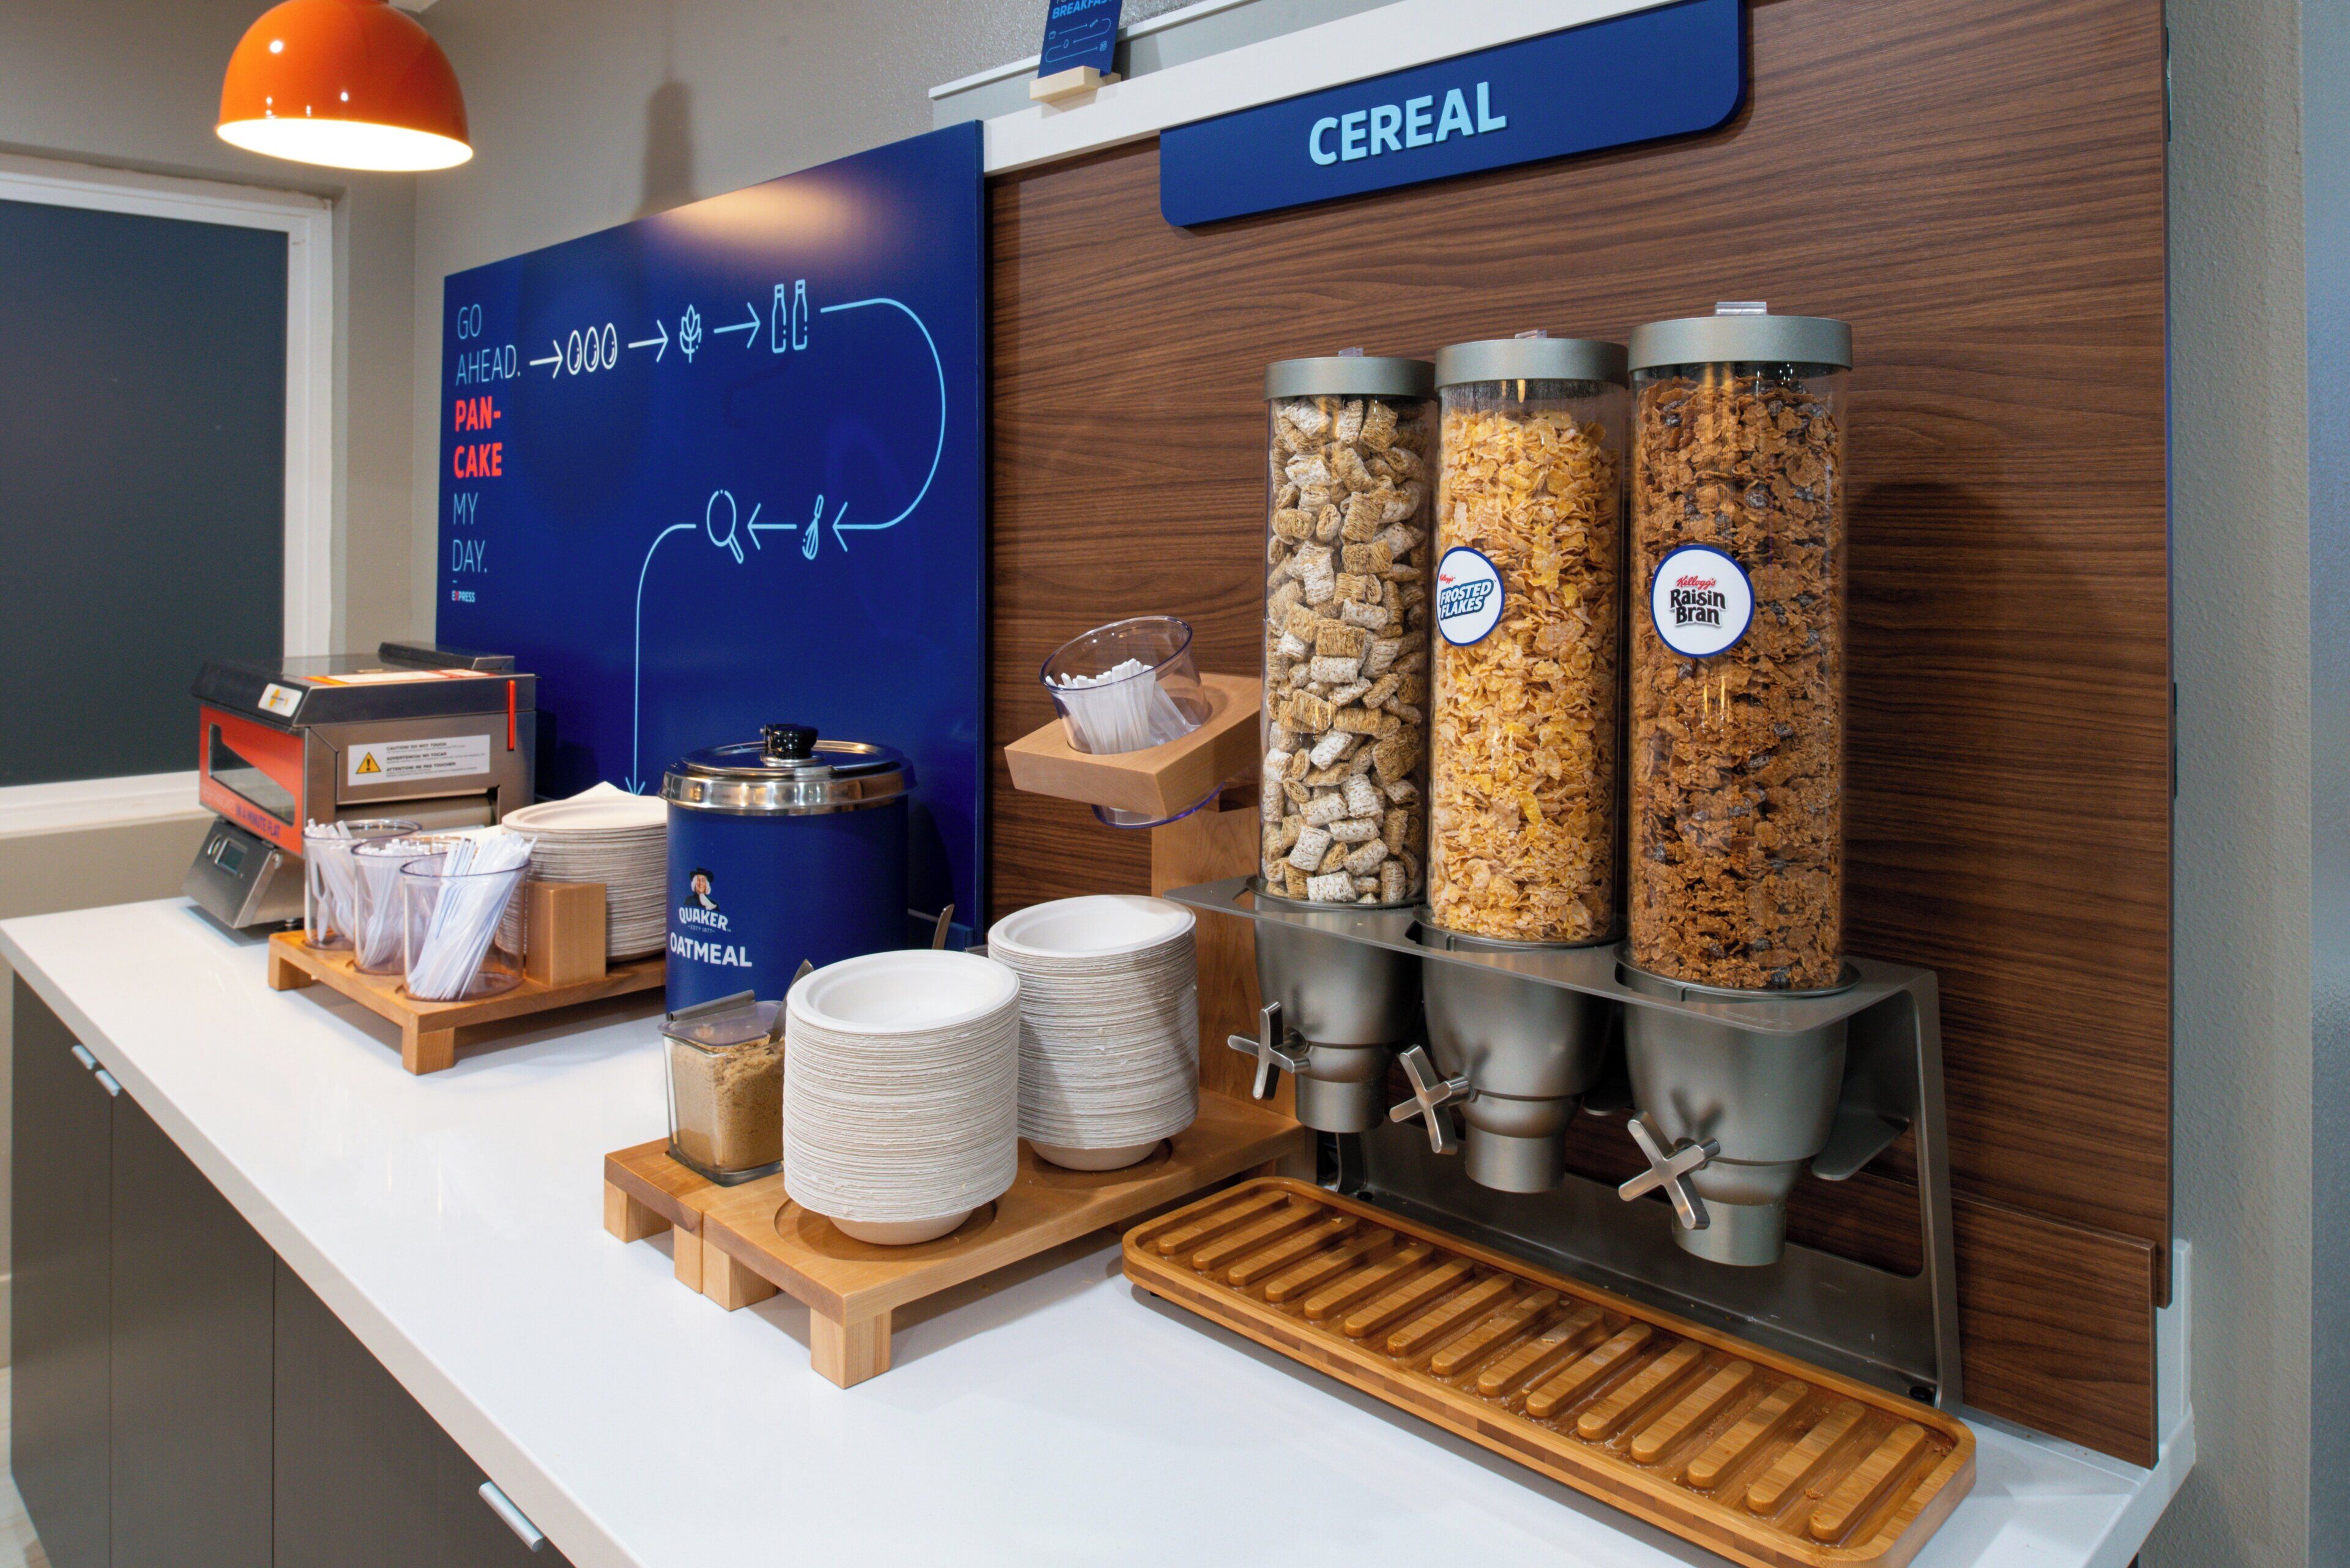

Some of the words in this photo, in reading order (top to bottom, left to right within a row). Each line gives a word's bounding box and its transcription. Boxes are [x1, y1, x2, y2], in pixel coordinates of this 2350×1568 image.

[1052, 0, 1112, 19] BREAKFA
[1309, 81, 1507, 165] CEREAL
[457, 304, 482, 340] GO
[456, 345, 521, 386] AHEAD.
[455, 396, 501, 431] PAN-
[453, 442, 502, 479] CAKE
[453, 492, 479, 525] MY
[452, 539, 487, 573] DAY.
[452, 591, 475, 602] EXPRESS
[1440, 581, 1493, 606] FROSTED
[1676, 575, 1717, 590] Kellogg's
[1440, 596, 1484, 619] FLAKES
[1670, 589, 1726, 609] Raisin
[1676, 605, 1721, 625] Bran
[679, 907, 728, 931] QUAKER
[670, 931, 752, 967] OATMEAL
